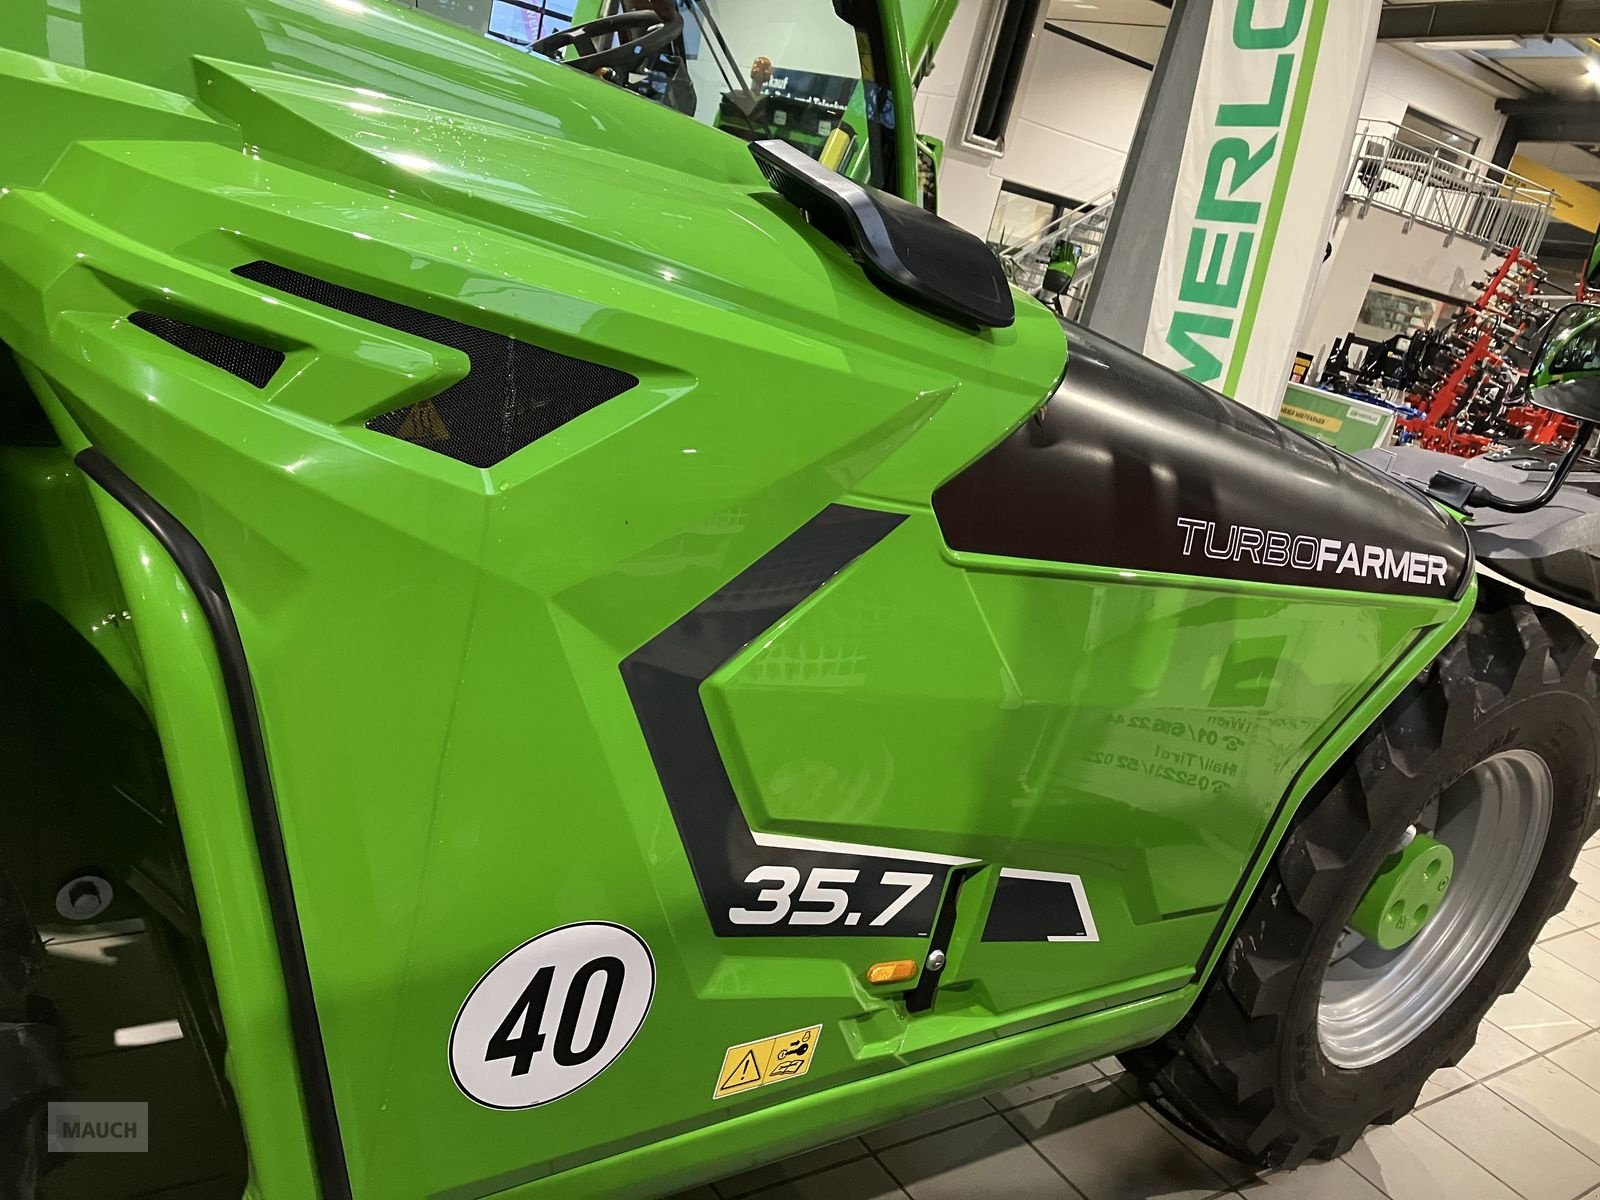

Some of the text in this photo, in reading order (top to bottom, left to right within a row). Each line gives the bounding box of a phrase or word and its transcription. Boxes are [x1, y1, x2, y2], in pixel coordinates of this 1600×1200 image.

[1176, 516, 1449, 587] TURBOFARMER
[728, 865, 934, 927] 35.7
[484, 956, 626, 1078] 40
